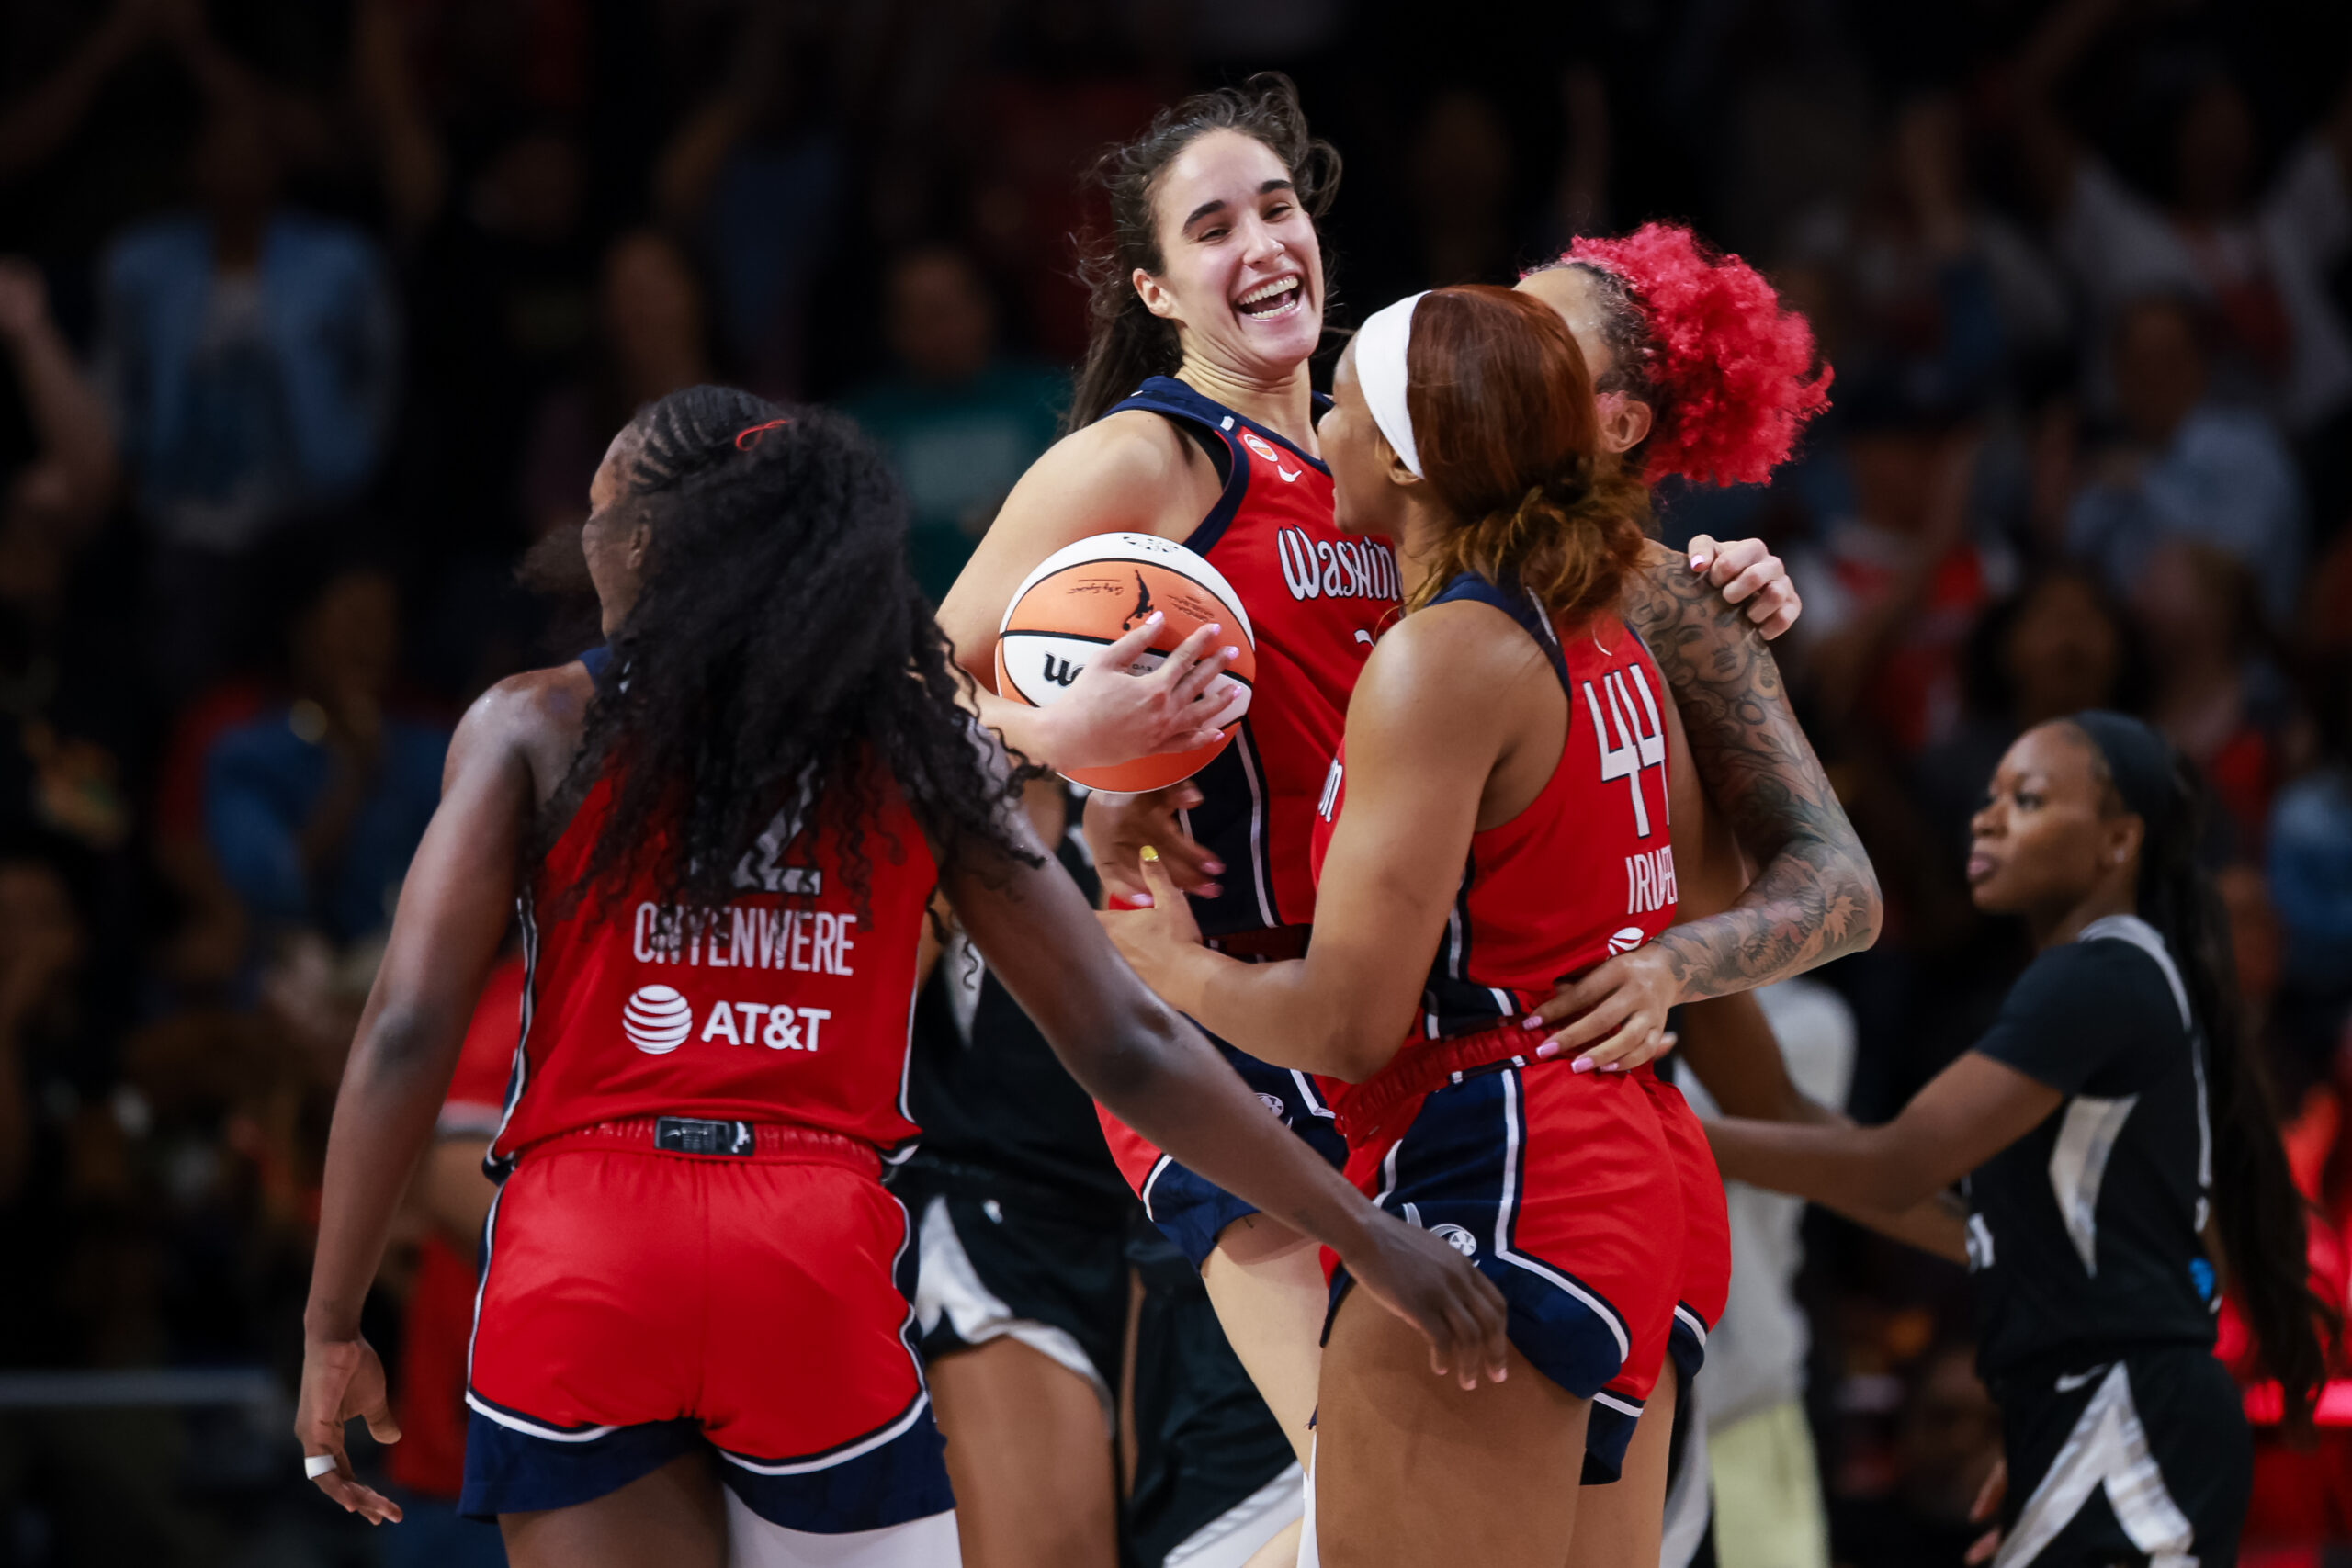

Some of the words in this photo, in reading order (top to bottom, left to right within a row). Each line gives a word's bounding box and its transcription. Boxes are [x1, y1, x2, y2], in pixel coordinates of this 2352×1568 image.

[1277, 525, 1403, 602] Washin
[1581, 661, 1669, 838] 44
[700, 1000, 831, 1052] AT&T
